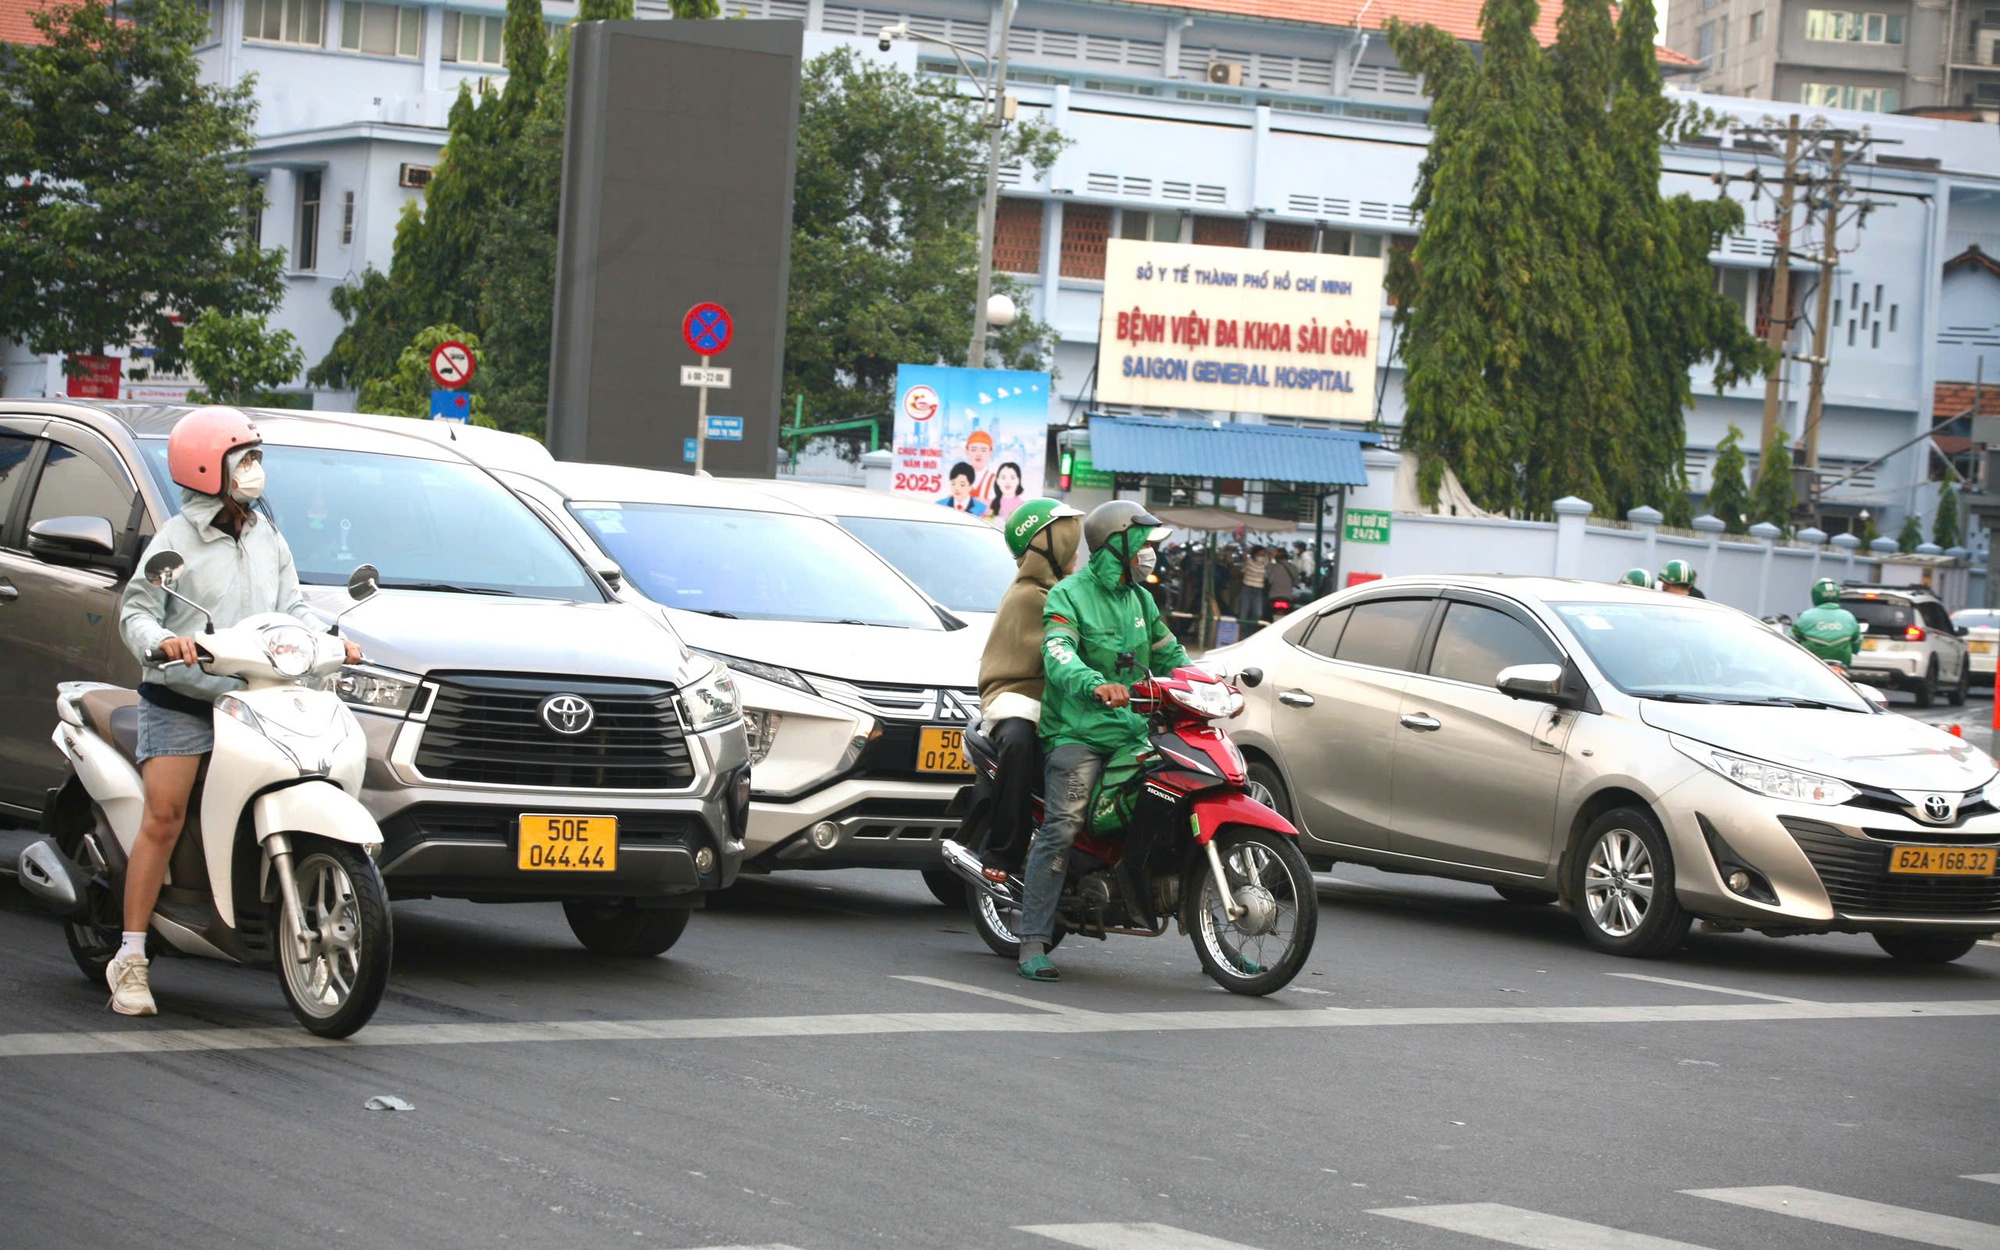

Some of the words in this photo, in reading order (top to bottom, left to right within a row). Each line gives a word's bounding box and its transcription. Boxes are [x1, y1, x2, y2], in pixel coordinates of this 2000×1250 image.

[1137, 261, 1153, 280] SỞ
[1158, 267, 1167, 281] Y
[1173, 263, 1190, 283] TẾ
[1195, 268, 1237, 287] THÀNH
[1243, 269, 1269, 289] PHỐ
[1296, 275, 1318, 292] CHÍ
[1321, 280, 1352, 295] MINH
[1117, 306, 1165, 347] BỆNH
[1171, 309, 1210, 352] VIỆN
[1215, 319, 1238, 348] ĐA
[1244, 321, 1291, 352] KHOA
[1297, 317, 1327, 354] SÀI
[1331, 319, 1368, 357] GÒN
[1123, 355, 1188, 381] SAIGON
[1193, 360, 1269, 387] GENERAL
[1275, 366, 1354, 393] HOSPITAL
[894, 472, 942, 493] 2025
[1015, 514, 1039, 537] Grab
[1377, 516, 1388, 528] XE
[1352, 528, 1381, 540] 24/24
[1816, 621, 1843, 631] Grab
[941, 731, 962, 749] 50
[1147, 786, 1176, 804] HONDA
[548, 819, 589, 842] 50E
[530, 845, 605, 868] 044.44
[1899, 851, 1989, 870] 62A-168.32
